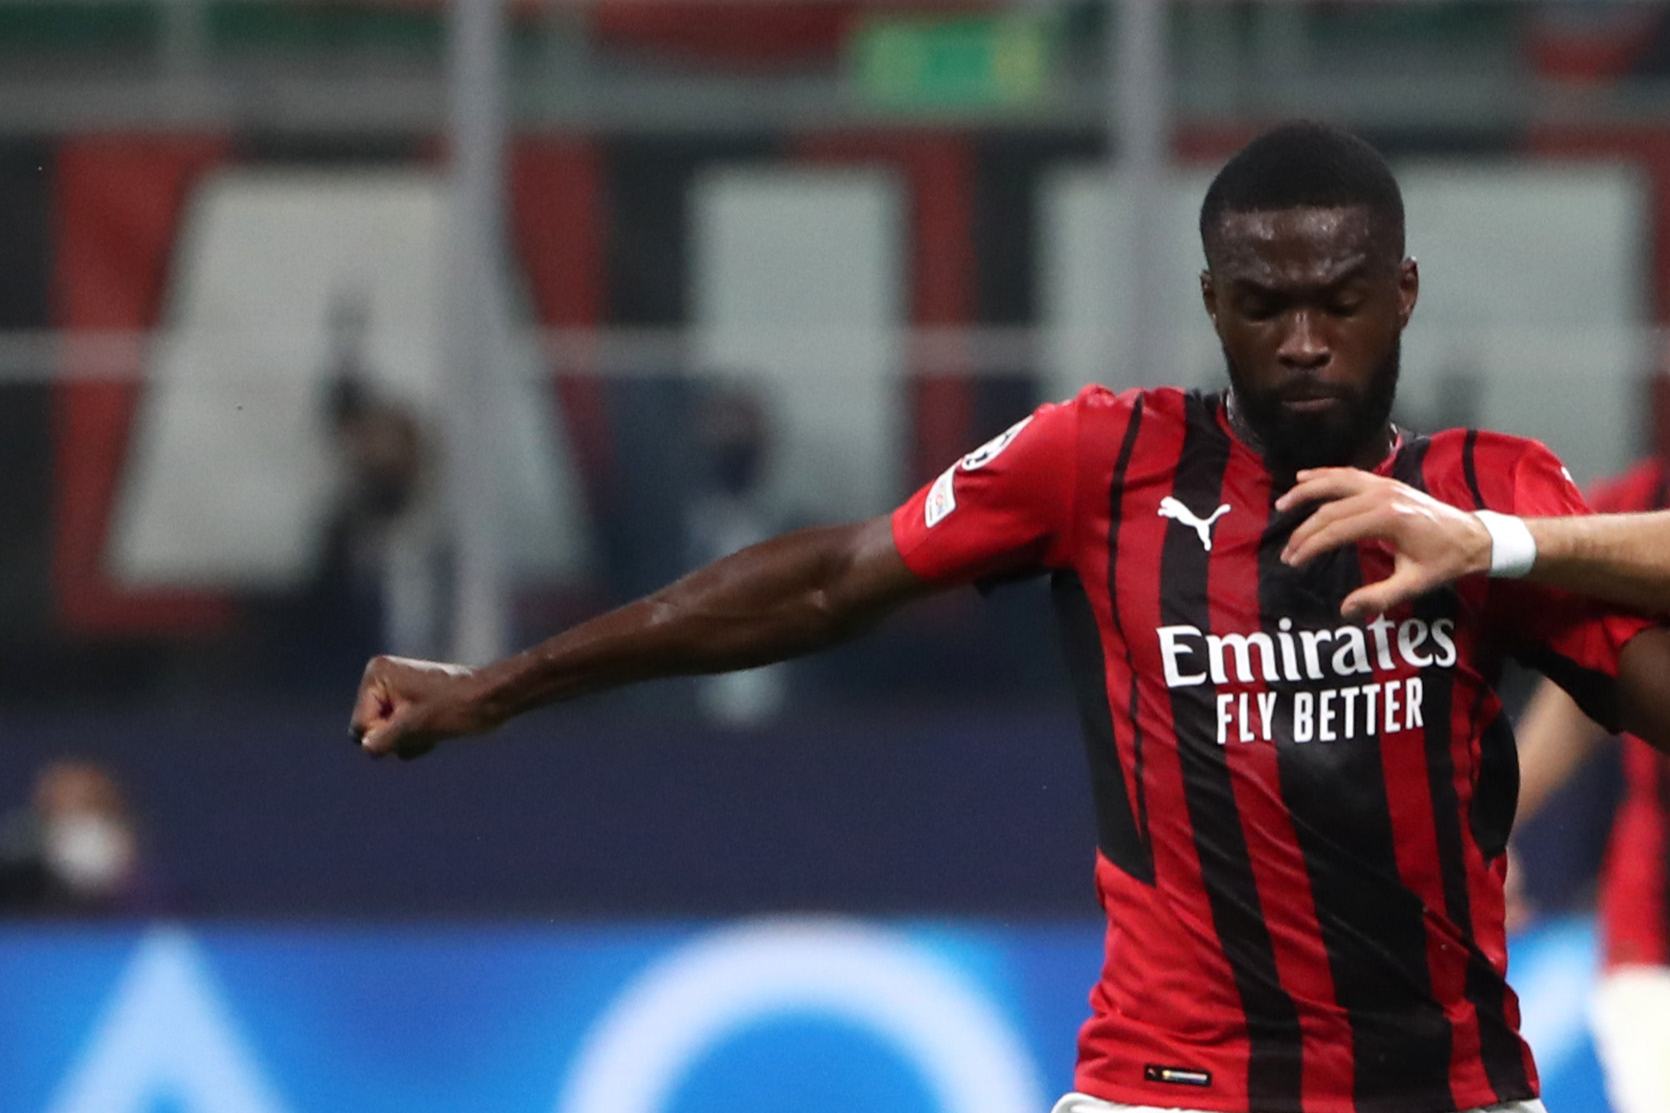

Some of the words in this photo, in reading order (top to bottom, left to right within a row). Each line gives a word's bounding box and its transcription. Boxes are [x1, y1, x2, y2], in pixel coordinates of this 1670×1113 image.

[1157, 613, 1457, 687] Emirates
[1216, 692, 1276, 744] FLY
[1294, 677, 1424, 742] BETTER
